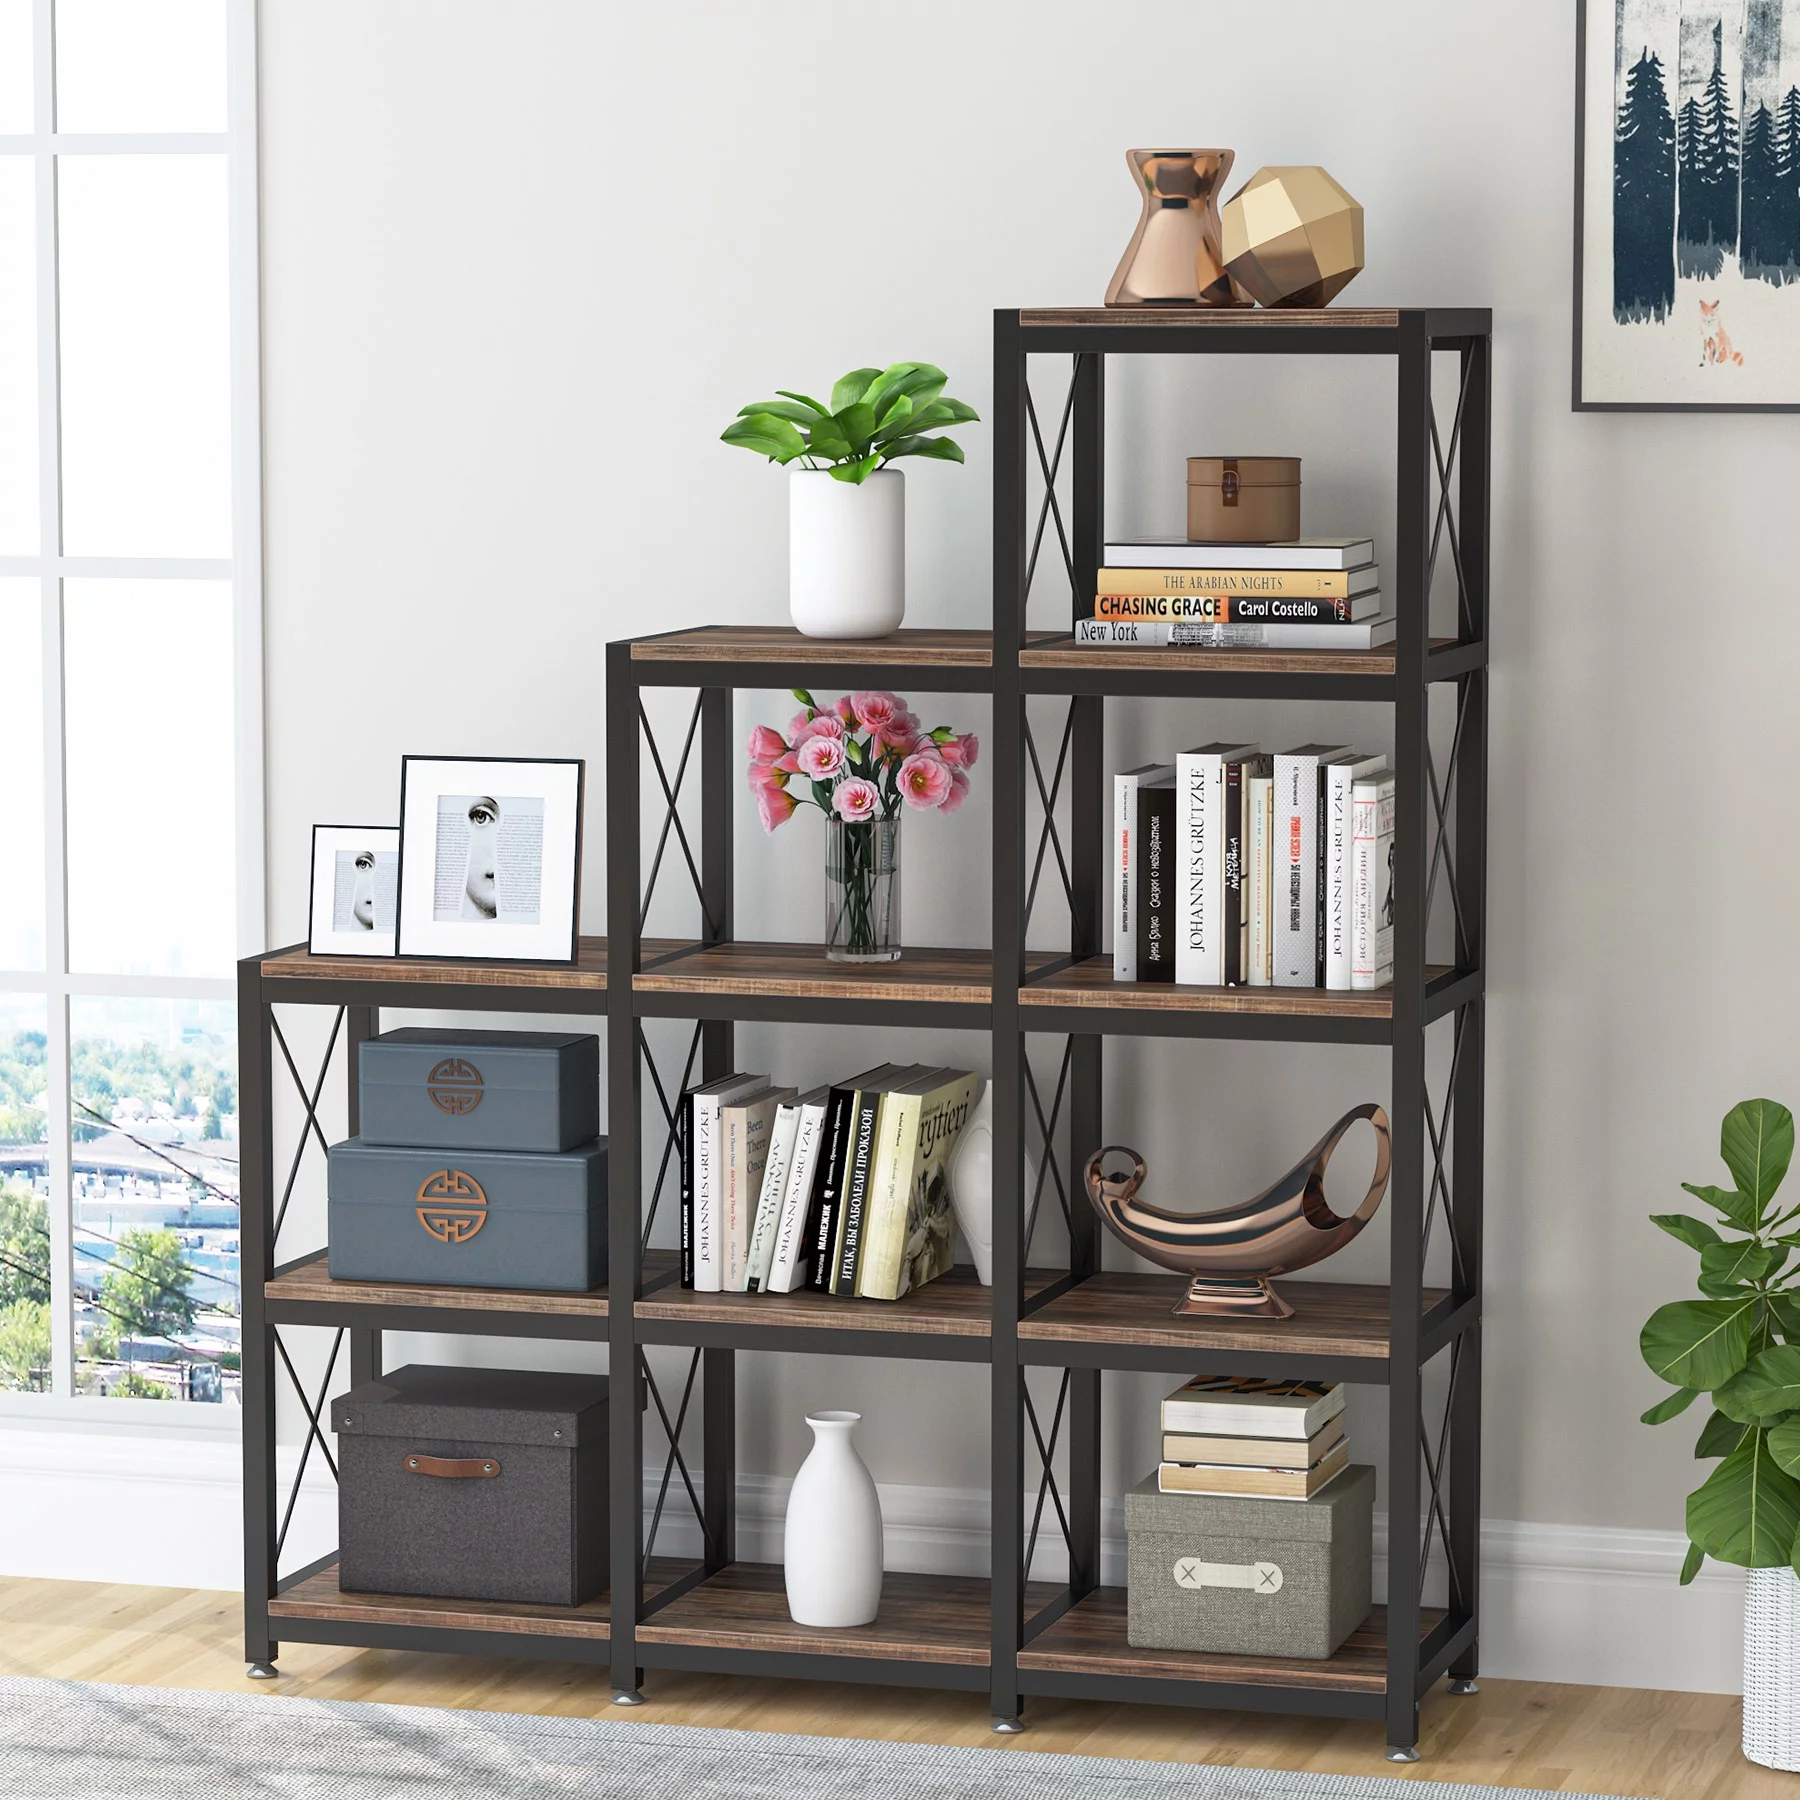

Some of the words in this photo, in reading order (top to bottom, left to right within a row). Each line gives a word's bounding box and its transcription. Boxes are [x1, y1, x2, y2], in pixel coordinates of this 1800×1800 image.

[1163, 575, 1185, 589] THE
[1188, 576, 1238, 590] ARABIAN
[1241, 576, 1283, 590] NIGHTS
[1100, 597, 1167, 615] CHASING
[1171, 597, 1222, 616] GRACE
[1238, 600, 1269, 616] Carol
[1271, 601, 1318, 617] Costello
[1080, 622, 1107, 641] New
[1110, 622, 1138, 641] York
[1188, 767, 1204, 854] GRÜTZKE
[1149, 815, 1162, 870] невозвратном
[1229, 837, 1240, 890] МЕТЕЛИЦА
[1149, 878, 1161, 908] Сказки
[1150, 870, 1160, 878] о
[1360, 850, 1368, 898] АНГЛИИ
[1149, 915, 1161, 940] Бялко
[1189, 857, 1205, 952] JOHANNES
[1333, 865, 1343, 958] JOHANNES
[1149, 941, 1161, 962] Анна
[1359, 903, 1367, 959] ИСТОРИЯ
[699, 1106, 709, 1180] GRÜTZKE
[746, 1120, 763, 1134] Been
[746, 1138, 767, 1154] There
[856, 1108, 874, 1169] ПРОКАЗОЙ
[848, 1170, 866, 1227] ЗАБОЛЕЛИ
[700, 1182, 710, 1263] JOHANNES
[778, 1187, 800, 1264] JOHANNES
[817, 1204, 832, 1250] МАЛЕЖИК
[845, 1227, 859, 1246] ВЫ
[842, 1246, 858, 1280] ИТАК,
